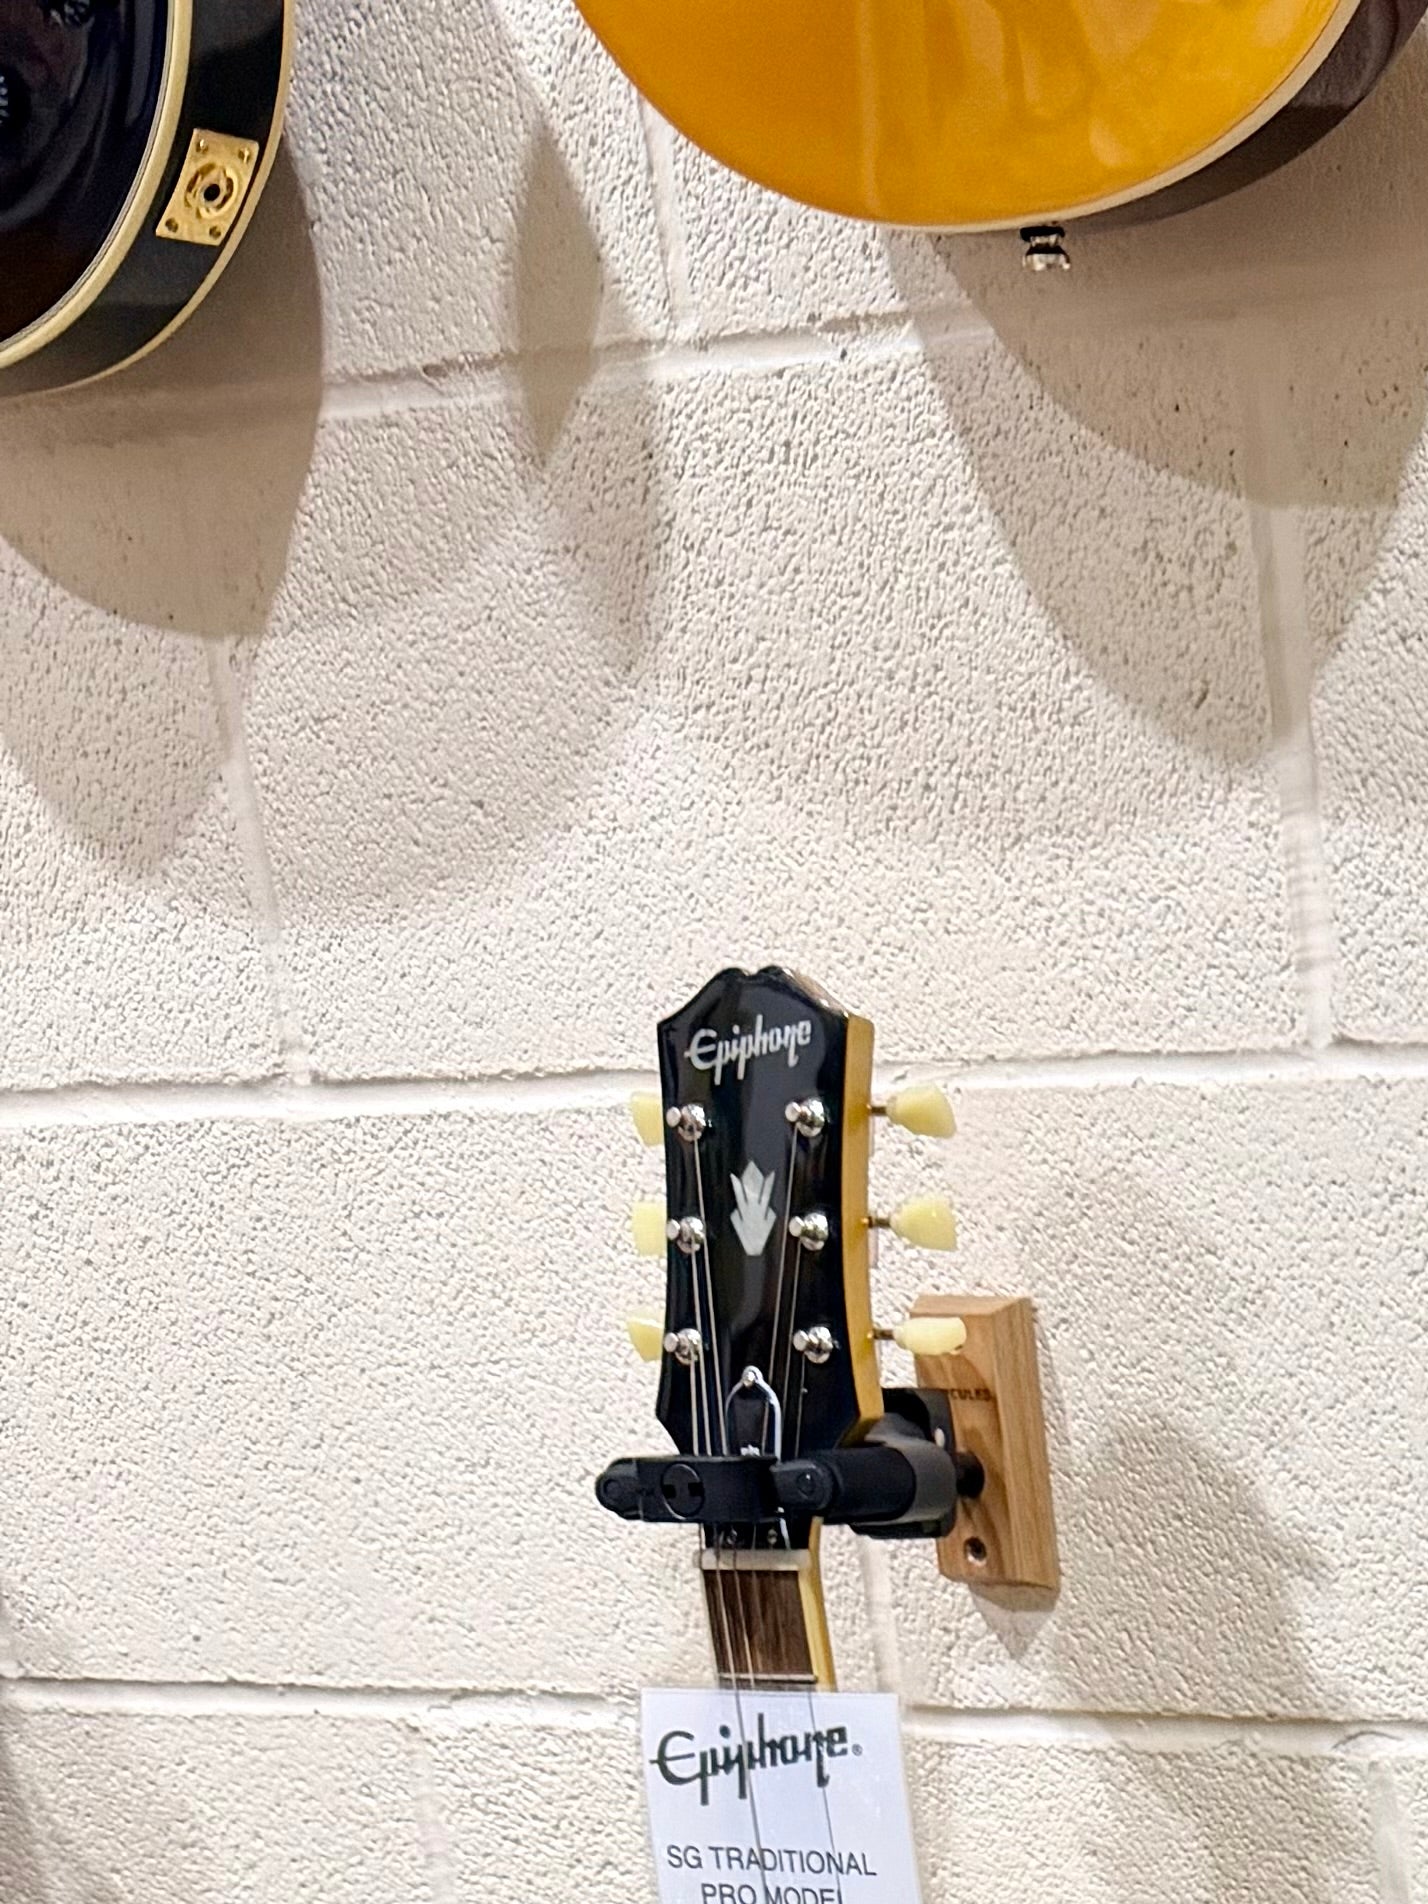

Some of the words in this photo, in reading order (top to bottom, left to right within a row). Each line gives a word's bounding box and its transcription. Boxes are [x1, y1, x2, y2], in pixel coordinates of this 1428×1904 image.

[684, 1014, 812, 1086] Epiphone
[667, 1845, 702, 1869] SG
[708, 1846, 877, 1876] TRADITIONAL
